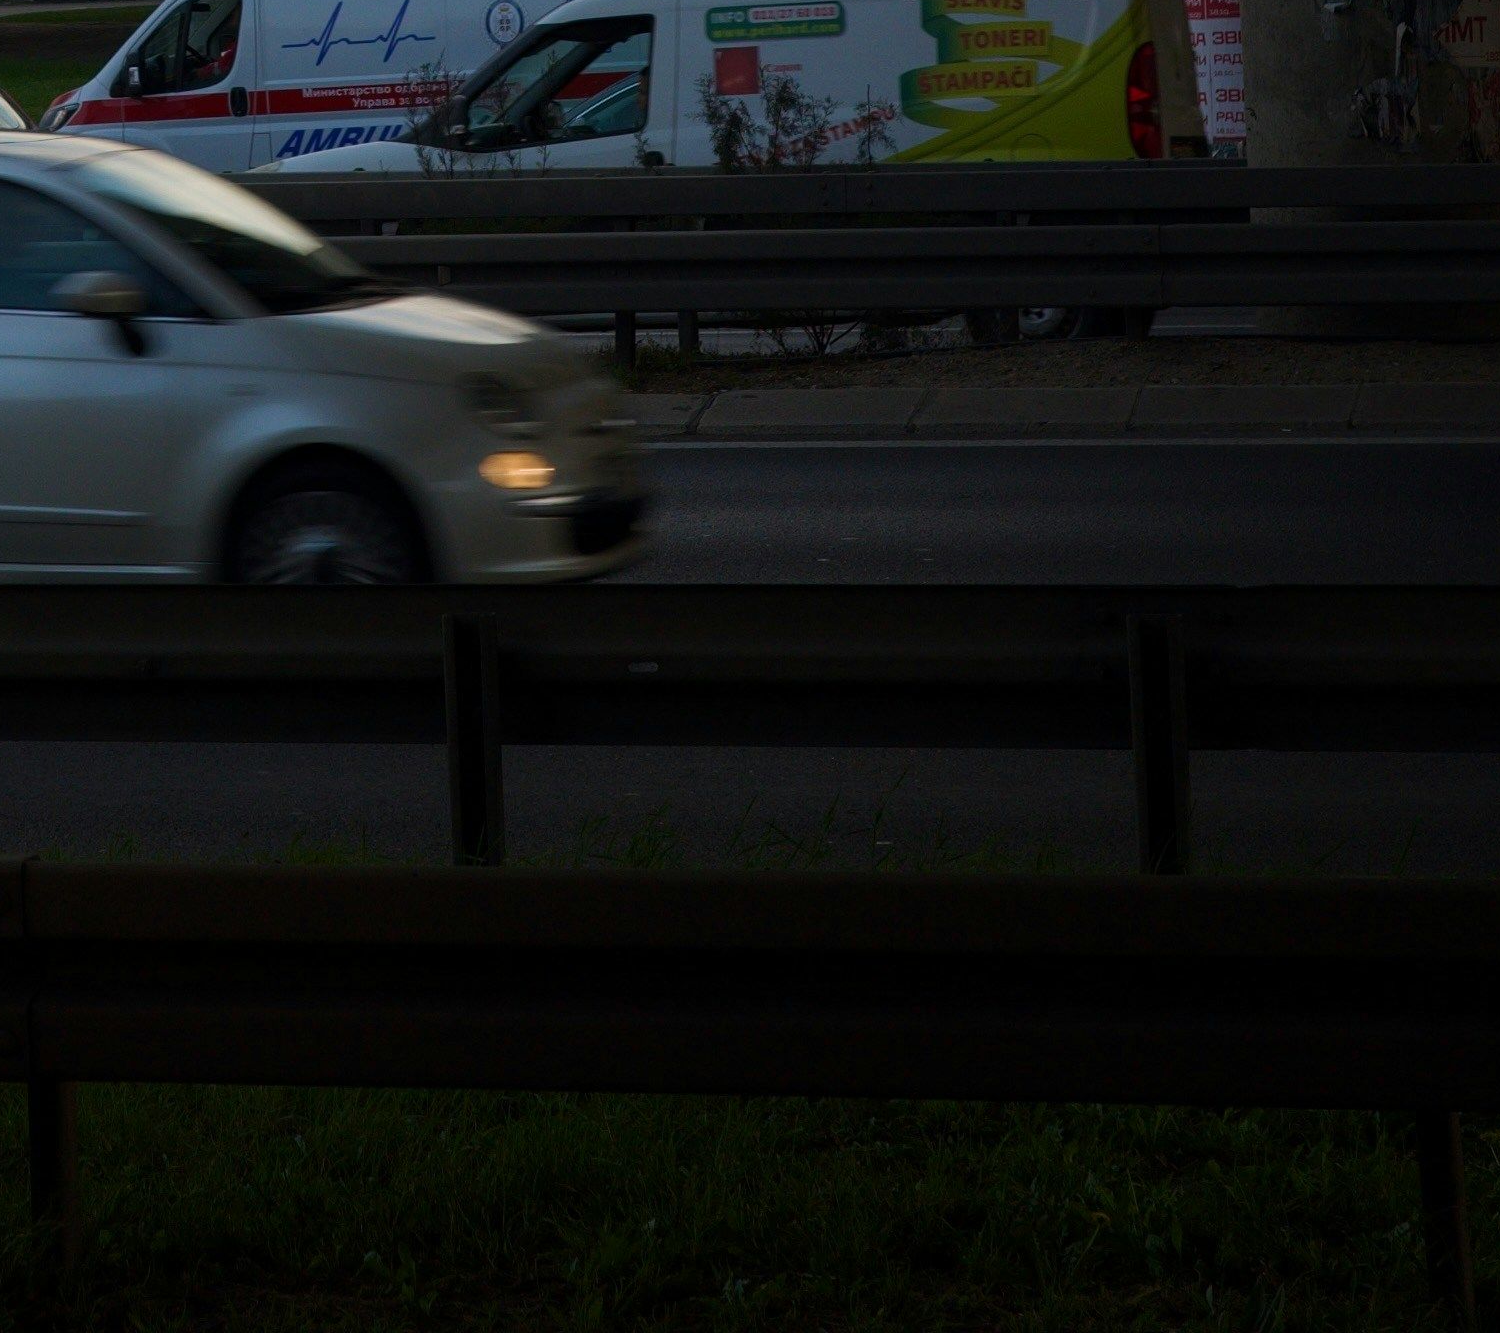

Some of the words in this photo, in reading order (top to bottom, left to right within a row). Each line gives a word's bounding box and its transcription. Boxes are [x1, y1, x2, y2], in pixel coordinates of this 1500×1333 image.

[961, 28, 1046, 50] TONERI
[302, 85, 392, 98] Министарство
[352, 97, 395, 108] Управа
